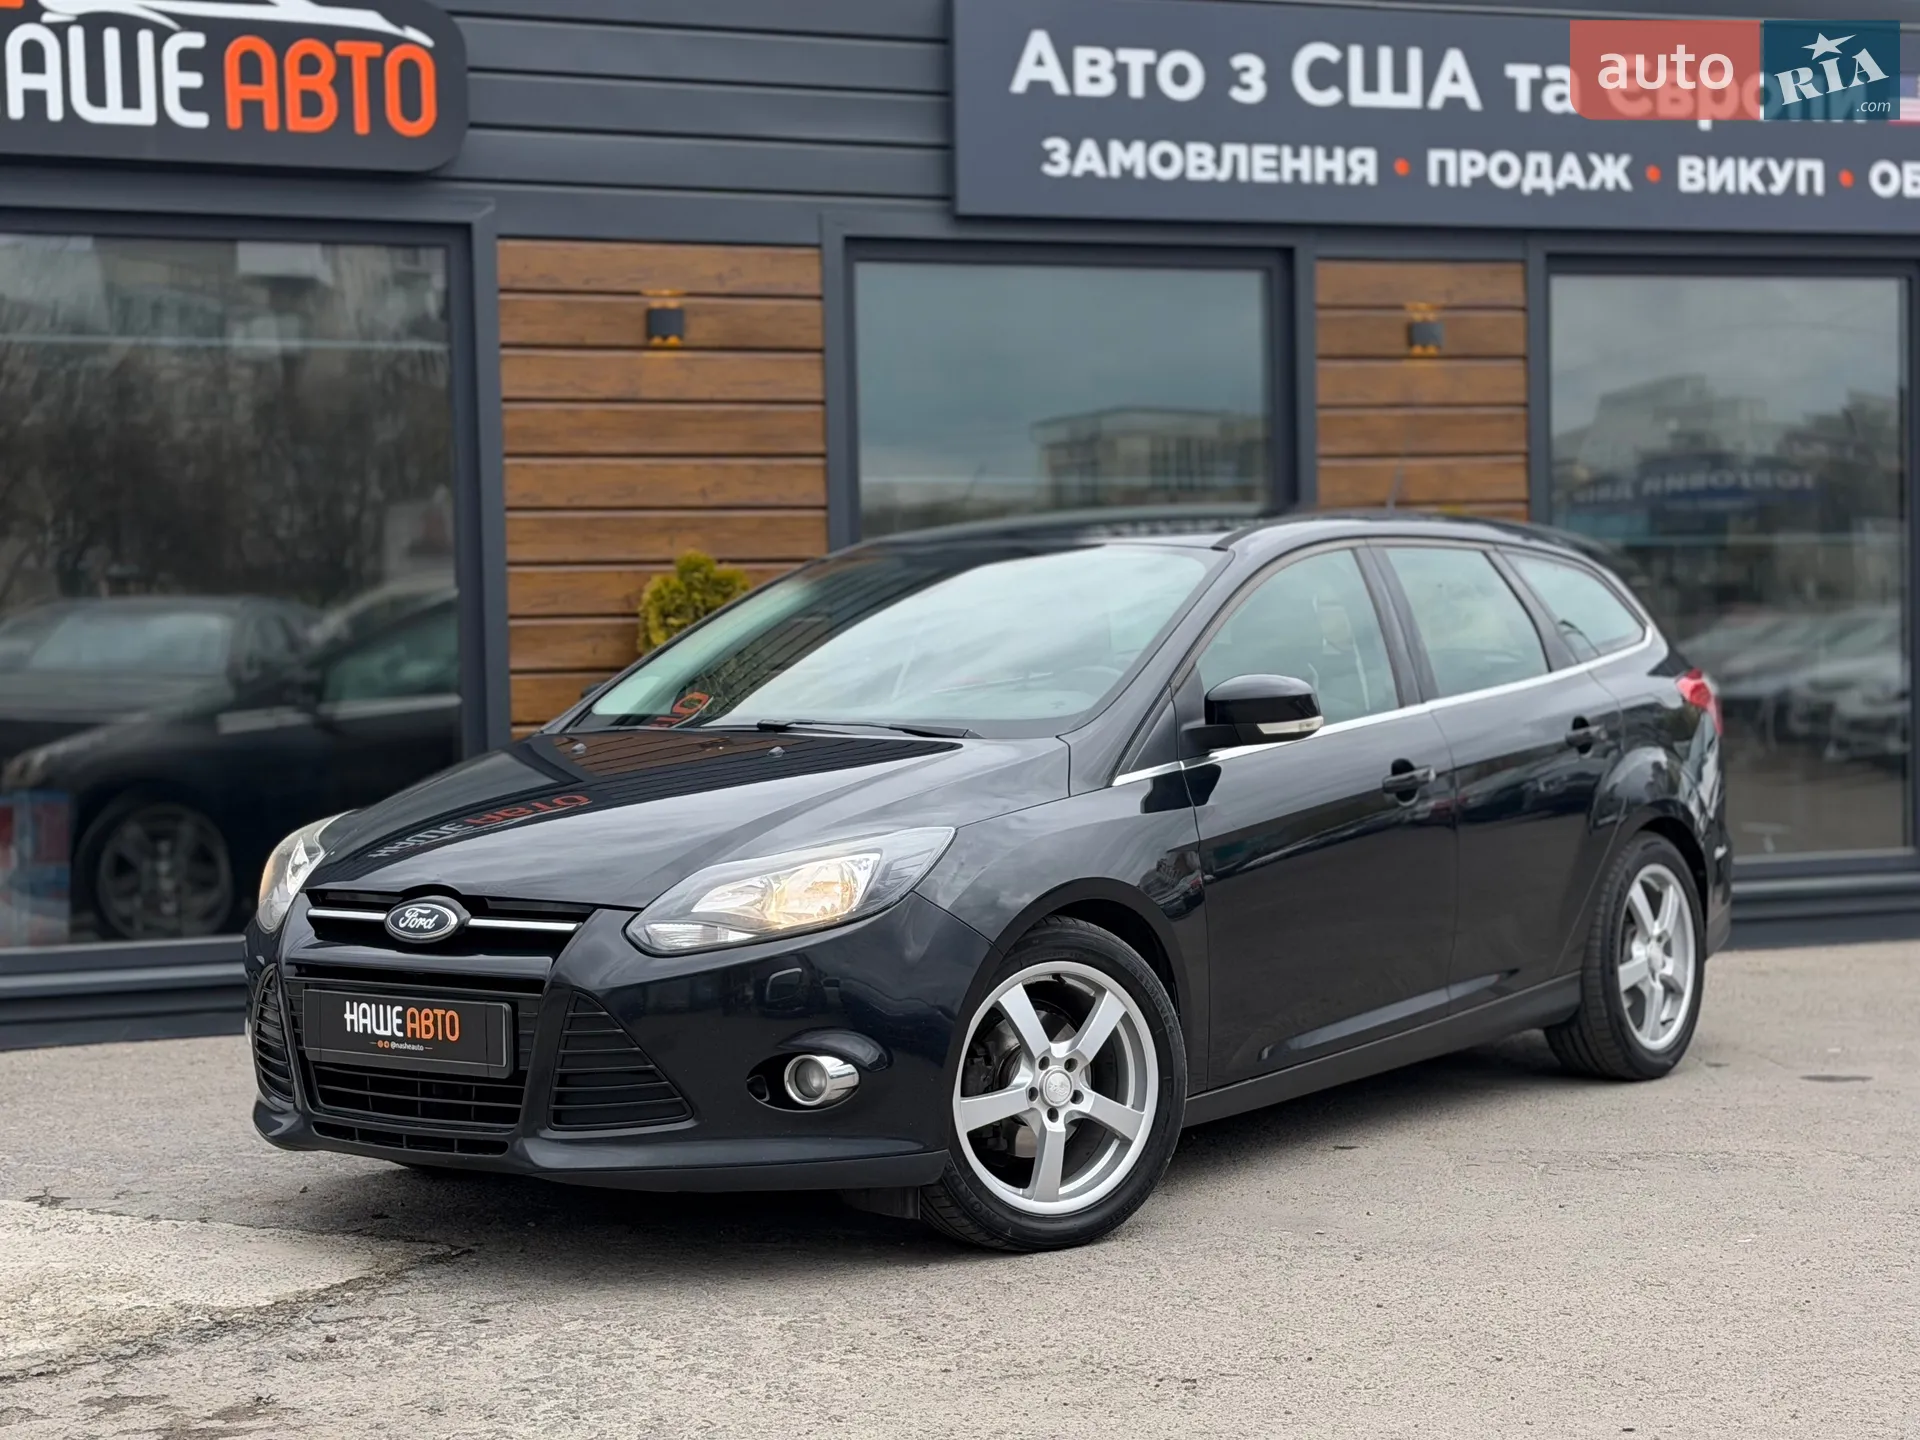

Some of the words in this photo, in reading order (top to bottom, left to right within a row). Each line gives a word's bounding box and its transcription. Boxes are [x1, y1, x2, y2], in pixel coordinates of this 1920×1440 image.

[224, 35, 438, 137] АВТО
[1010, 29, 1205, 101] Авто
[1291, 41, 1483, 111] США
[1041, 137, 1377, 186] ЗАМОВЛЕННЯ
[1427, 149, 1632, 196] ПРОДАЖ
[1678, 156, 1825, 196] ВИКУП
[398, 907, 439, 929] Ford
[343, 1001, 404, 1037] НАШЕ
[406, 1007, 460, 1041] АВТО
[390, 1041, 424, 1051] @nasheauto
